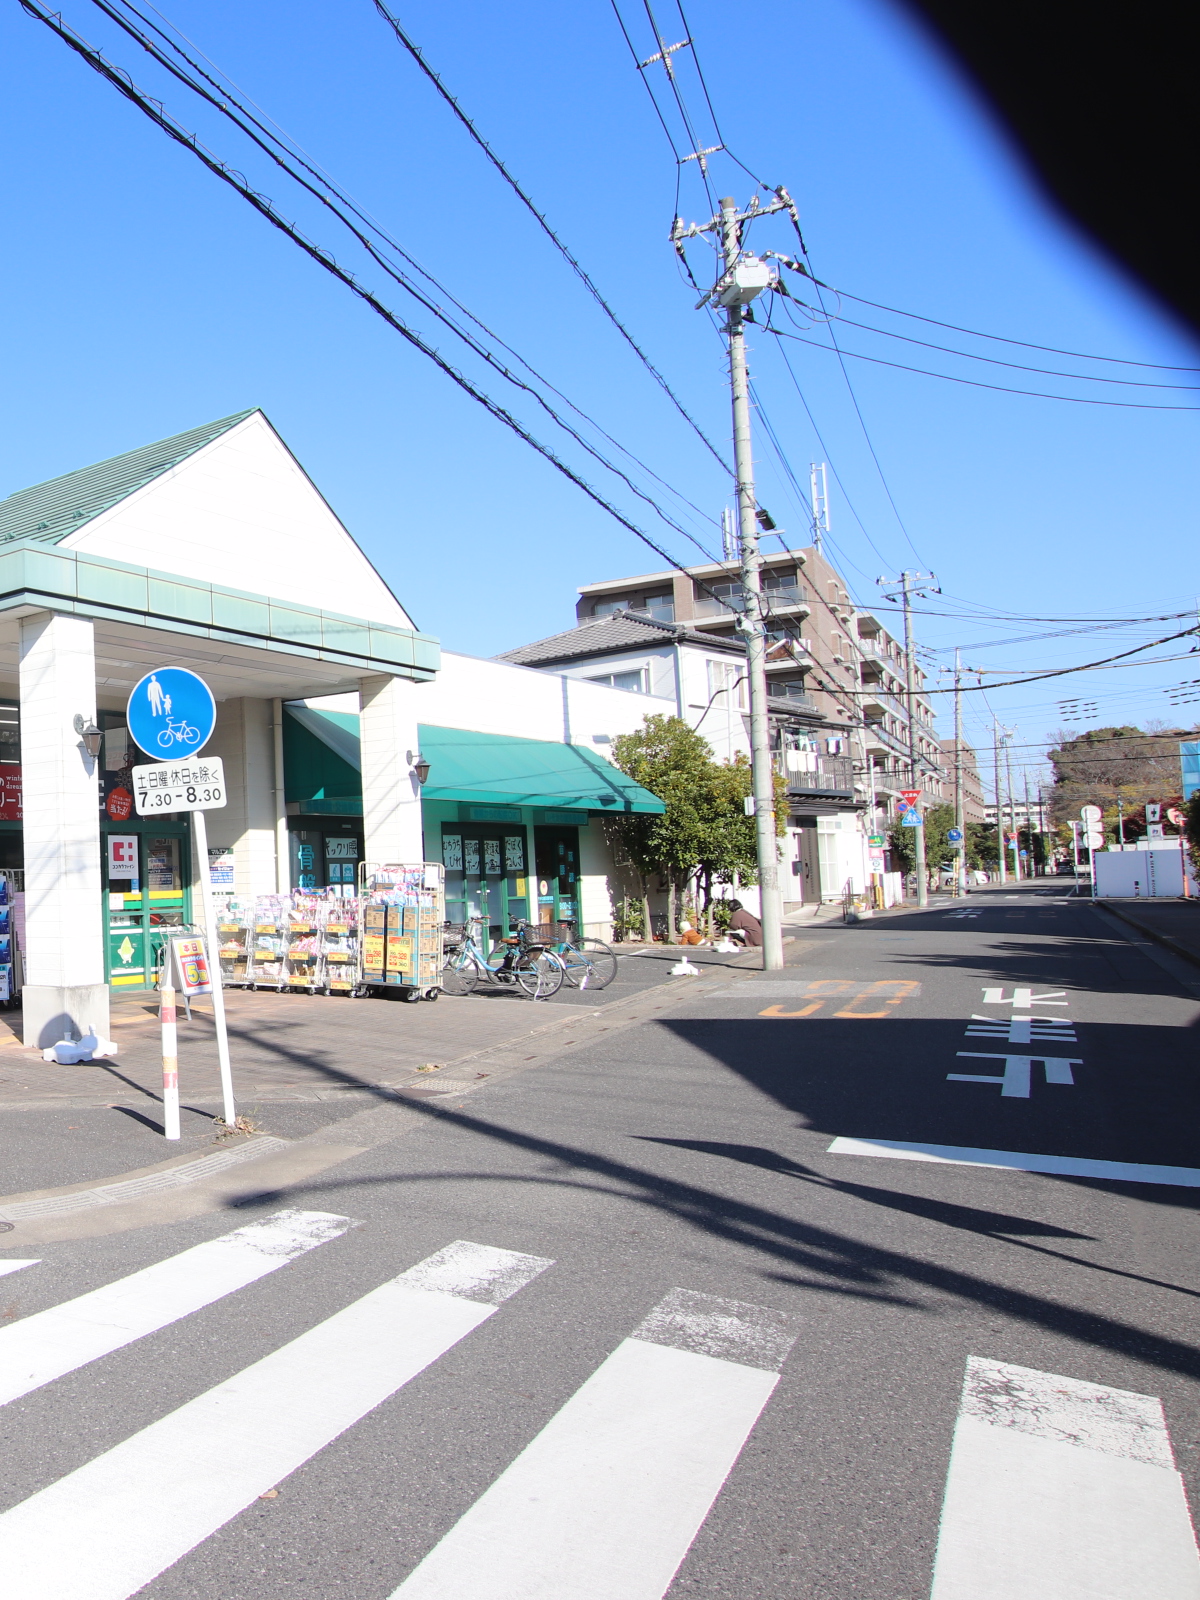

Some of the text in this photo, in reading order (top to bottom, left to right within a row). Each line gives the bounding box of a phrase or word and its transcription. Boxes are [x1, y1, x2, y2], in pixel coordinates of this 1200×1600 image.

[757, 979, 922, 1019] 30
[946, 987, 1084, 1098] 止まれ
